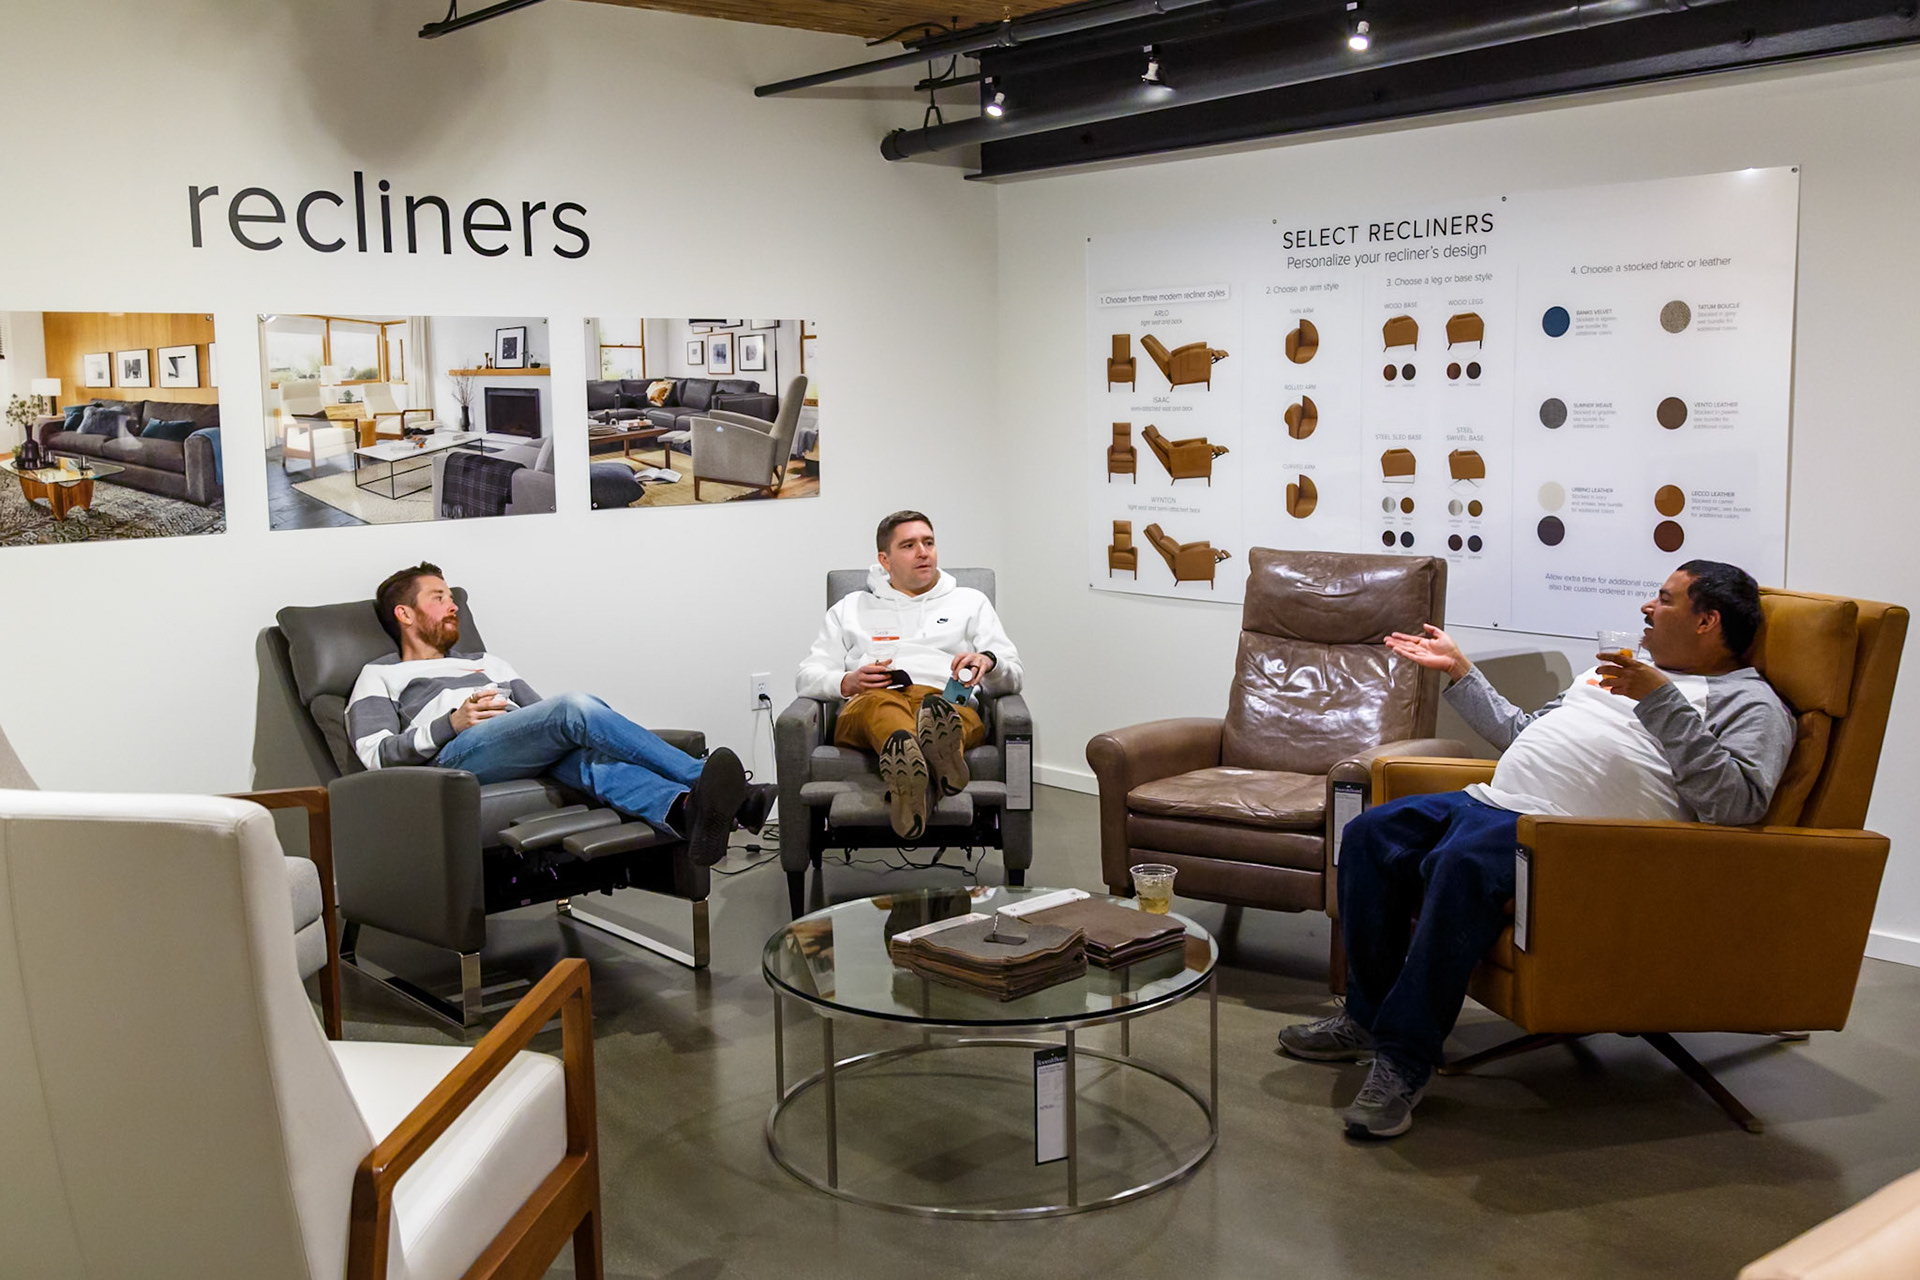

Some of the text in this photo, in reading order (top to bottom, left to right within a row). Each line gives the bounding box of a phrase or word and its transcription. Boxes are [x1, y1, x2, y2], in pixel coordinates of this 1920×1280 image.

[188, 170, 590, 259] recliners
[1282, 212, 1494, 250] SELECT RECLINERS
[1287, 242, 1487, 270] Personalize your recliner's design
[1571, 256, 1732, 275] 4. Choose a stocked fabric or leather
[1394, 277, 1422, 286] Choose
[1430, 275, 1443, 285] leg
[1444, 275, 1452, 283] or
[1454, 274, 1473, 283] base
[1474, 272, 1493, 283] style
[1273, 285, 1298, 294] Choose
[1310, 284, 1322, 292] arm
[1323, 283, 1340, 292] style
[1545, 572, 1562, 581] Allow
[1564, 574, 1581, 583] extra
[1582, 575, 1597, 583] time
[1597, 575, 1607, 584] for
[1608, 577, 1641, 587] additional
[1548, 583, 1657, 599] also be custom ordered in any of
